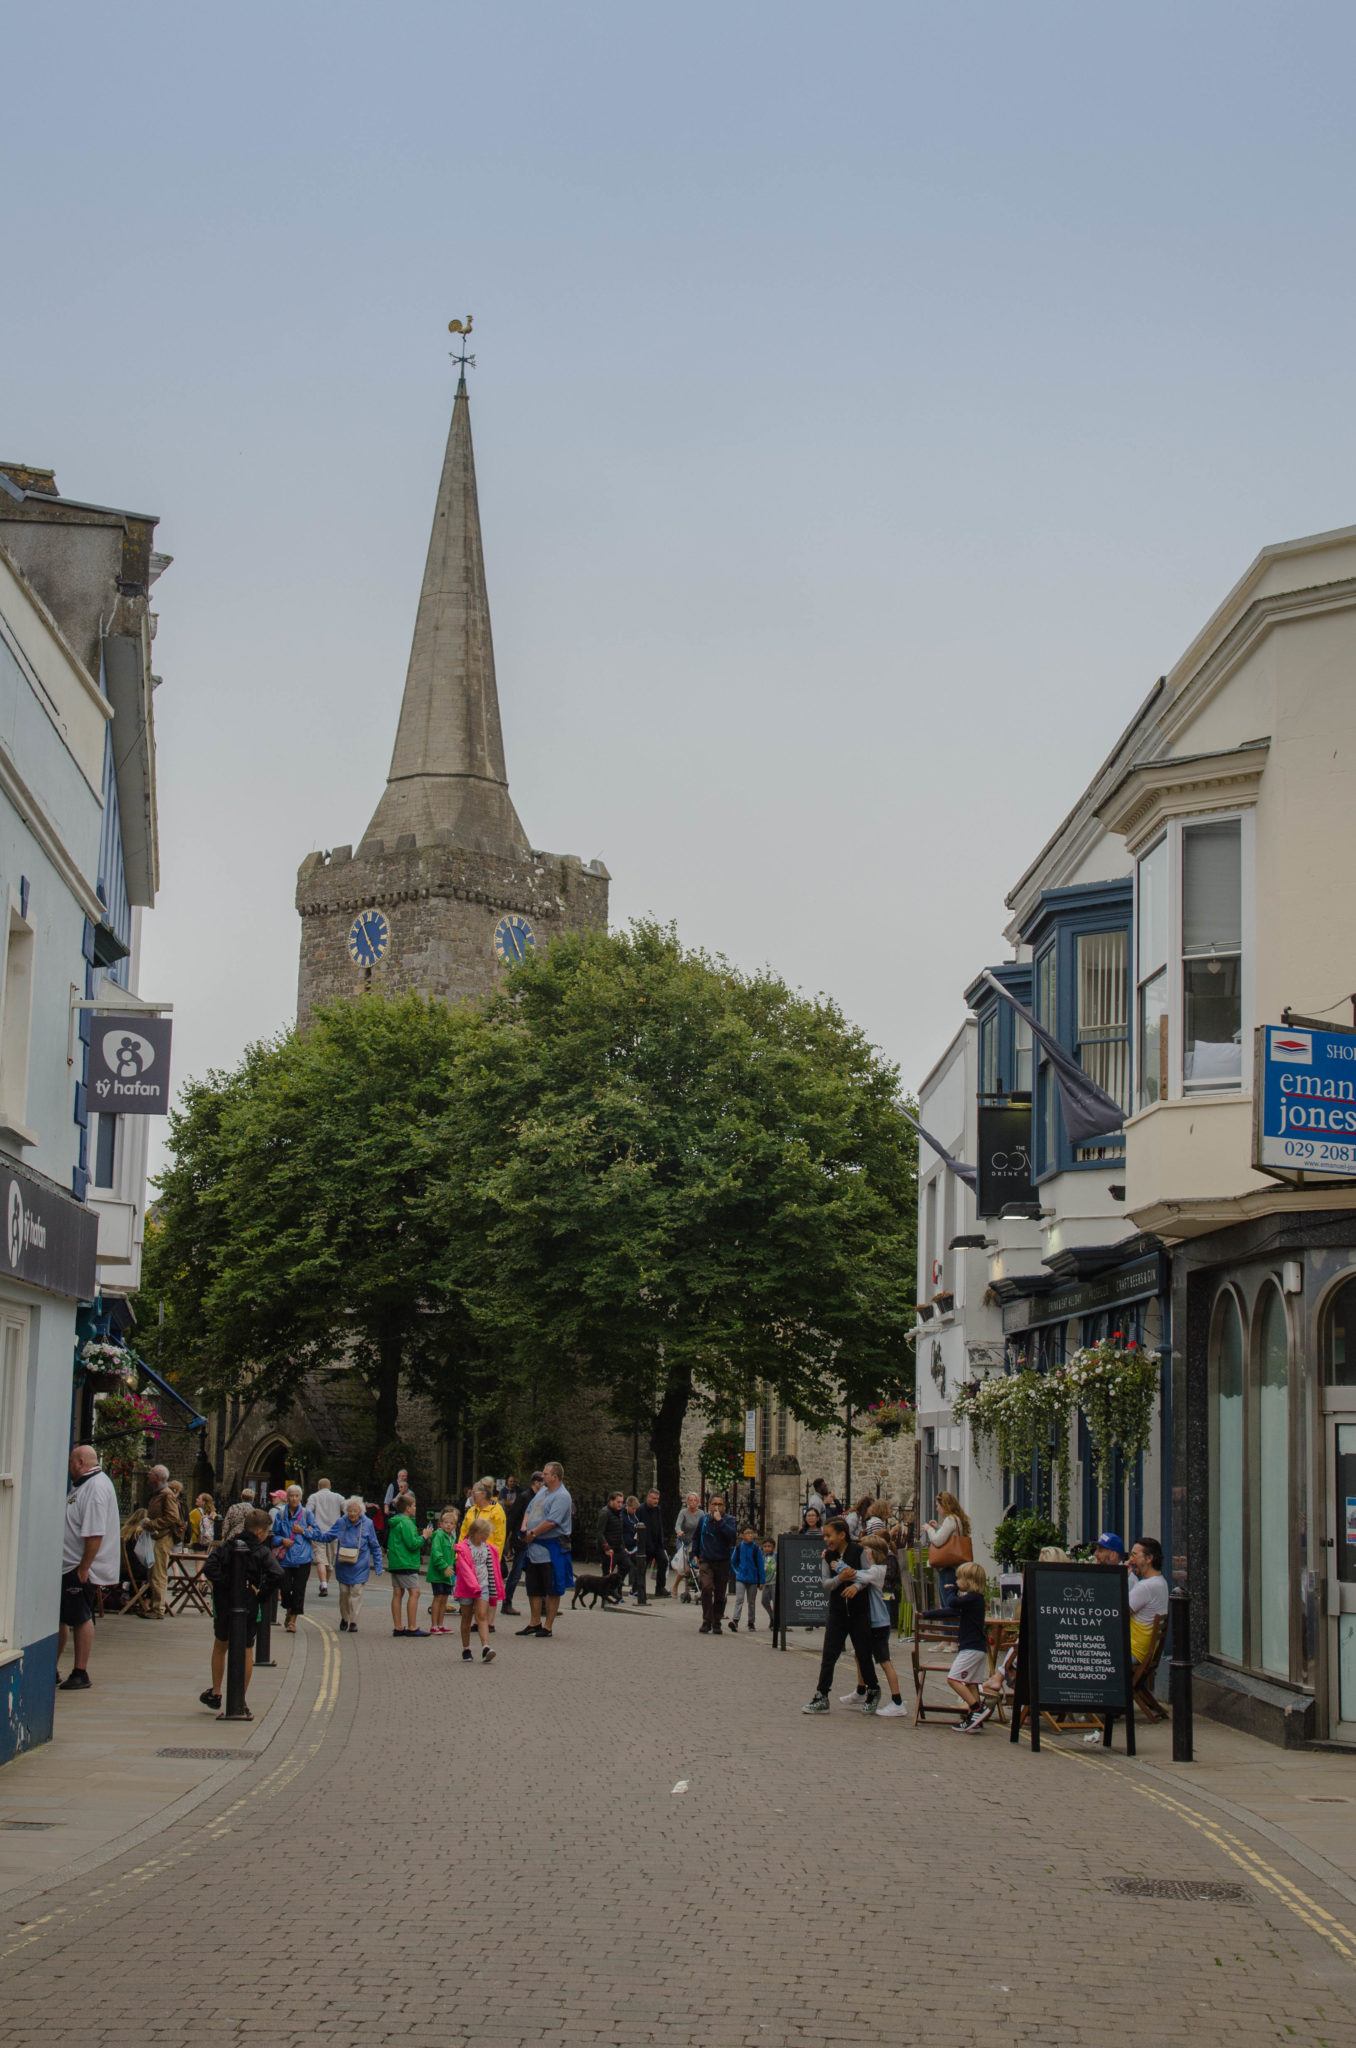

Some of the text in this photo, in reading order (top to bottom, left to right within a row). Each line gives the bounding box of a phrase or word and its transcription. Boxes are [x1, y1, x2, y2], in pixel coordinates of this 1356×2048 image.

[96, 1078, 160, 1098] tŷ hafan
[1278, 1097, 1356, 1135] jones
[1284, 1140, 1315, 1159] 029
[30, 1212, 46, 1249] hafan
[1130, 1272, 1143, 1288] BEERS
[1064, 1587, 1095, 1598] COVE
[1040, 1606, 1119, 1617] SERVING FOOD
[1081, 1618, 1102, 1626] DAY
